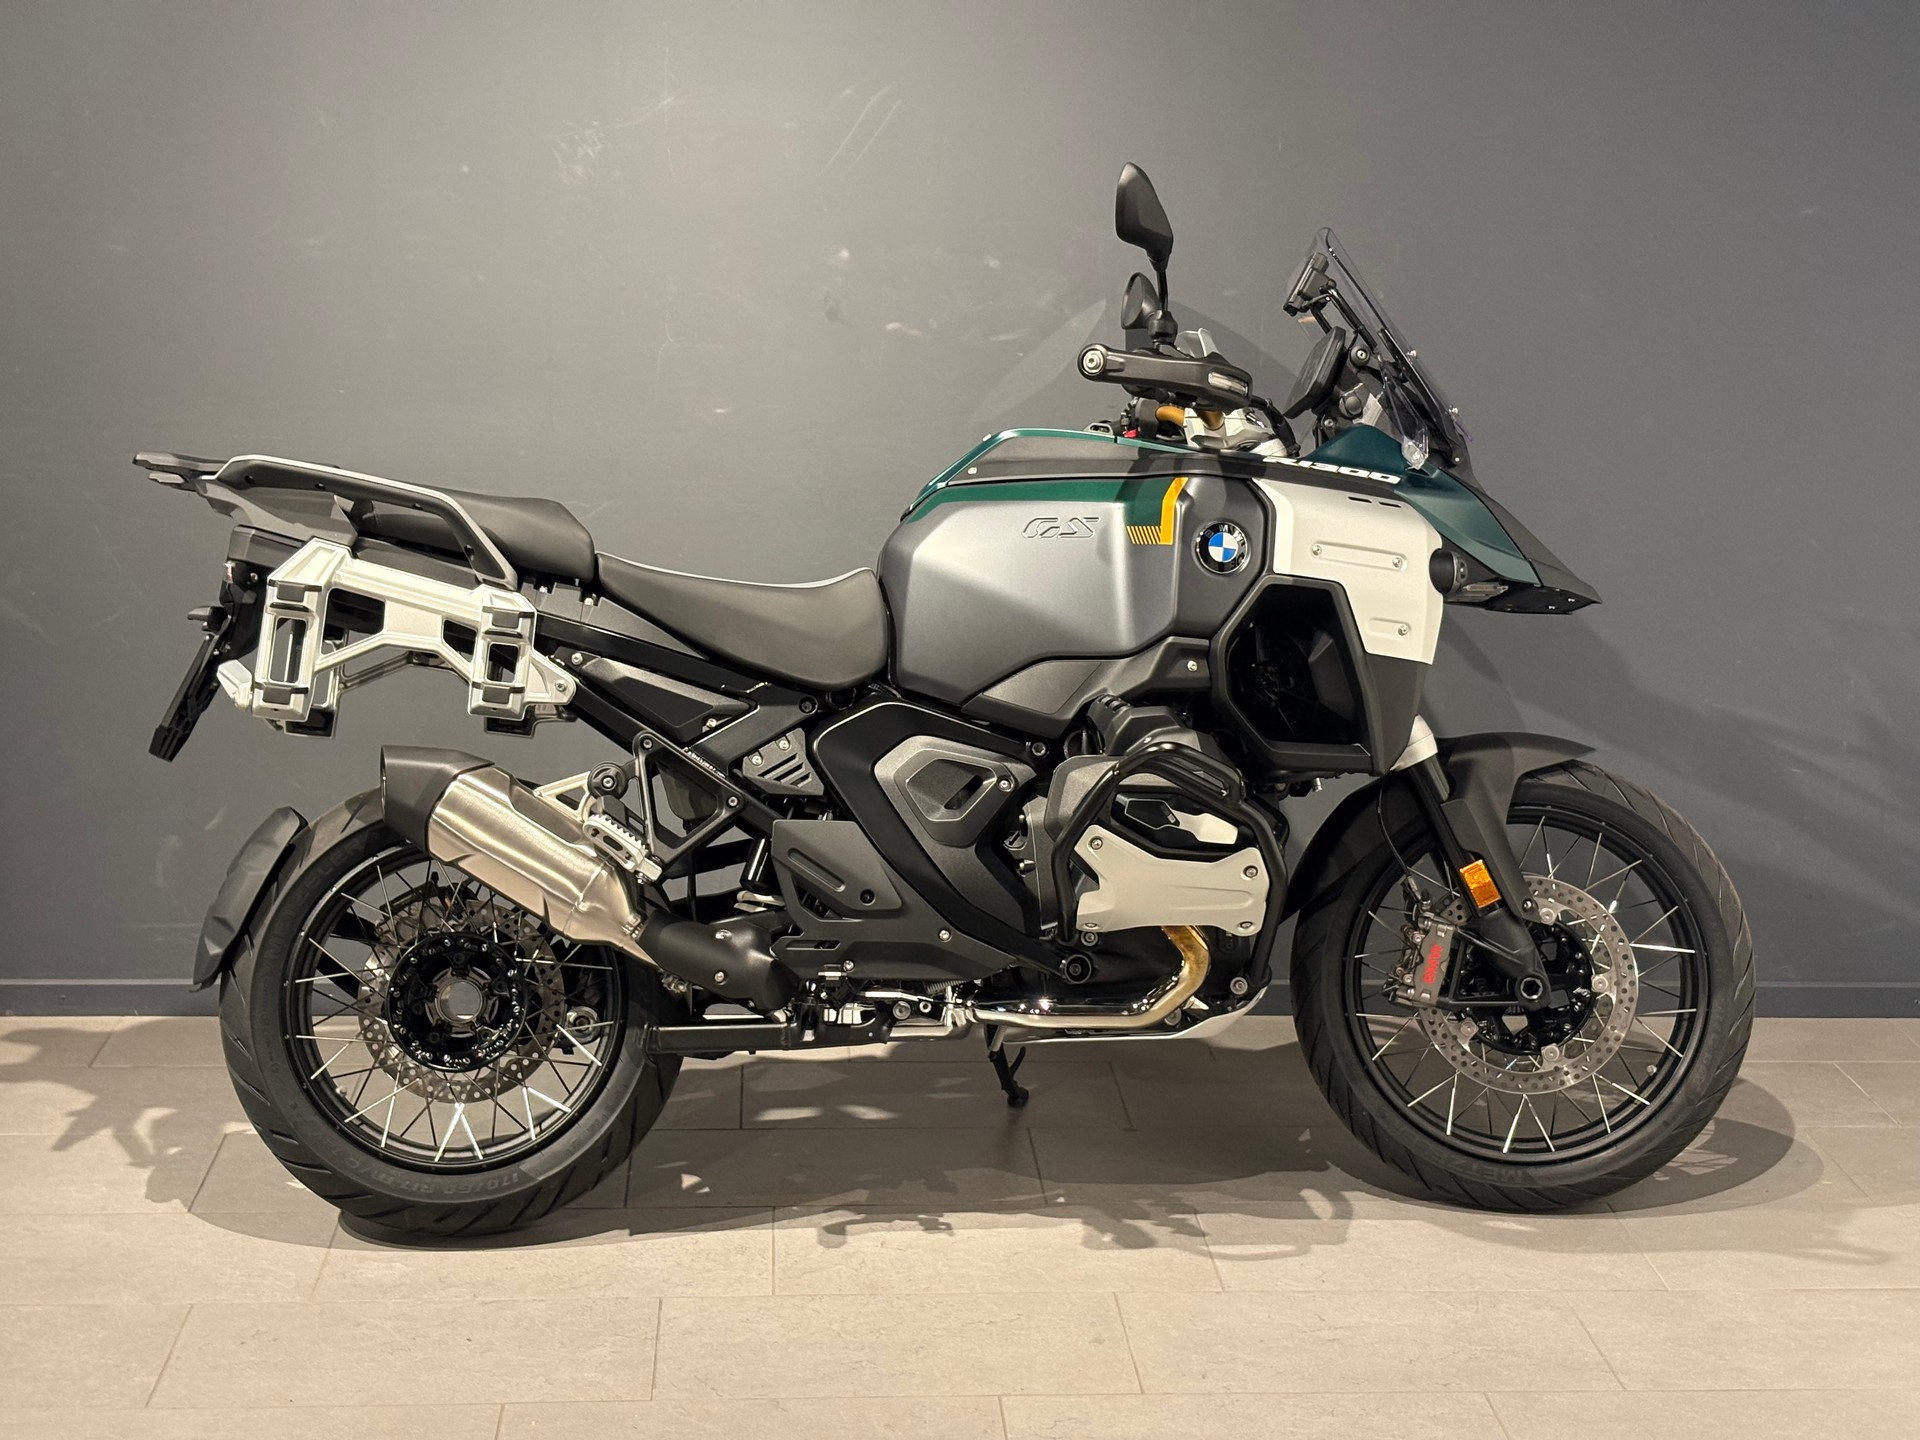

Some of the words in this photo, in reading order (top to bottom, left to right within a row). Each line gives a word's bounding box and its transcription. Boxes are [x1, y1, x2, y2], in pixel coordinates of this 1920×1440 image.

[1022, 517, 1099, 538] GS
[1203, 524, 1244, 544] BMW
[1424, 943, 1444, 984] BMW
